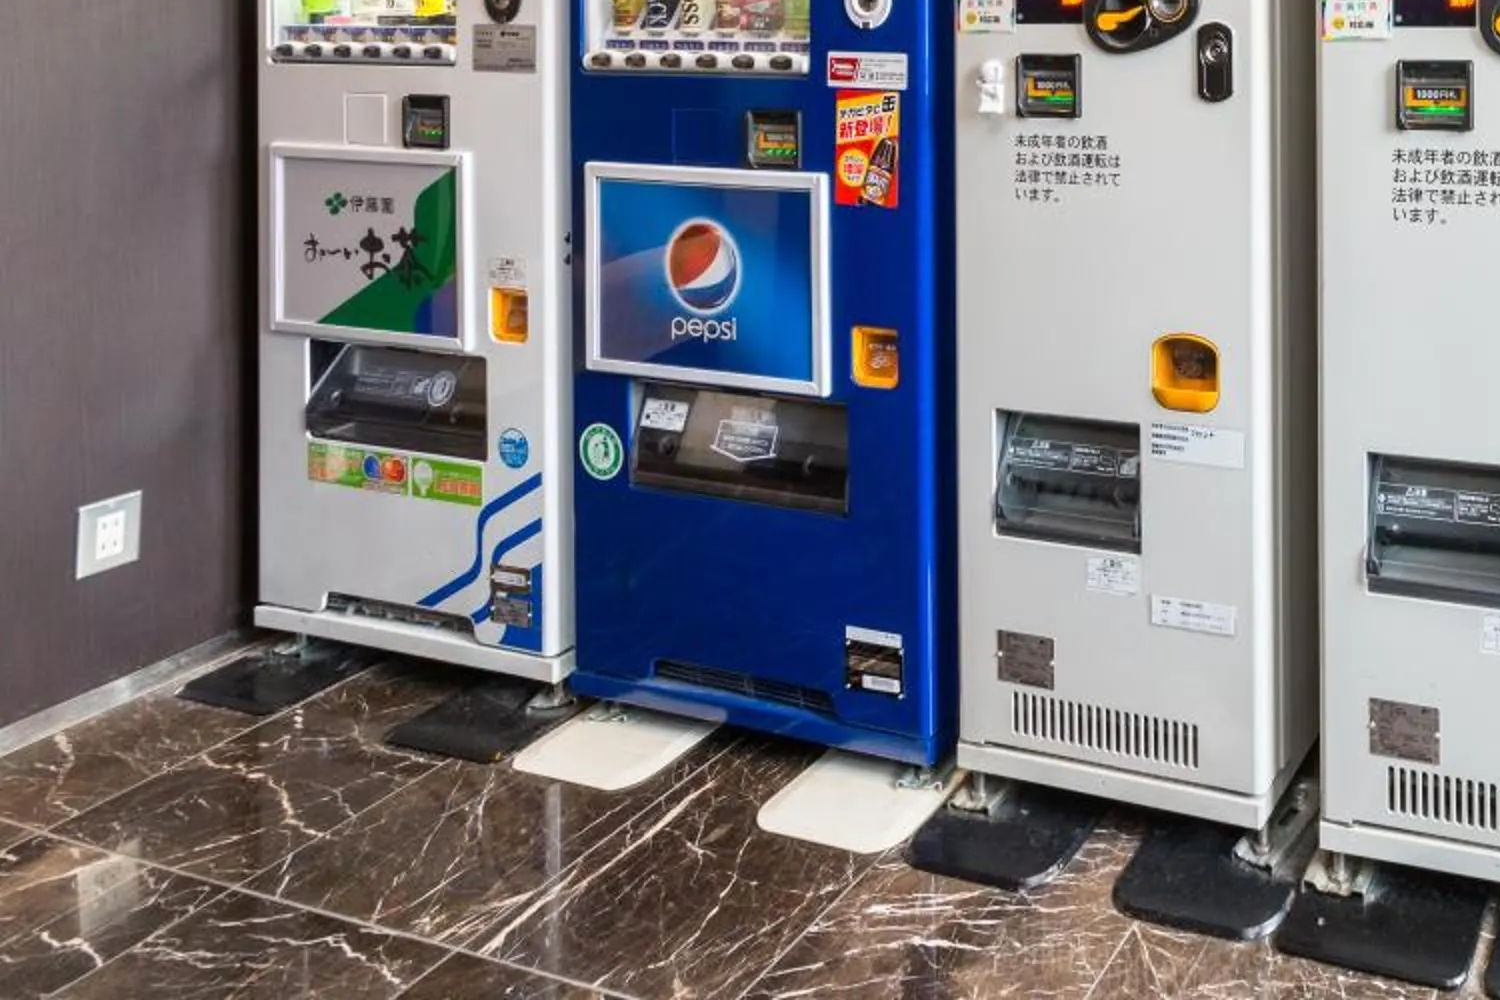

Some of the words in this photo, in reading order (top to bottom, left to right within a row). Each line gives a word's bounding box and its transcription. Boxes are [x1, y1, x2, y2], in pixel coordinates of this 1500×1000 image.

[1015, 135, 1107, 149] 未成年者の飲酒
[1015, 152, 1120, 168] および飲酒運転は
[1015, 169, 1121, 186] 法律で禁止されて
[1015, 188, 1060, 203] います。
[1393, 208, 1448, 225] います。
[671, 316, 737, 343] pepsi
